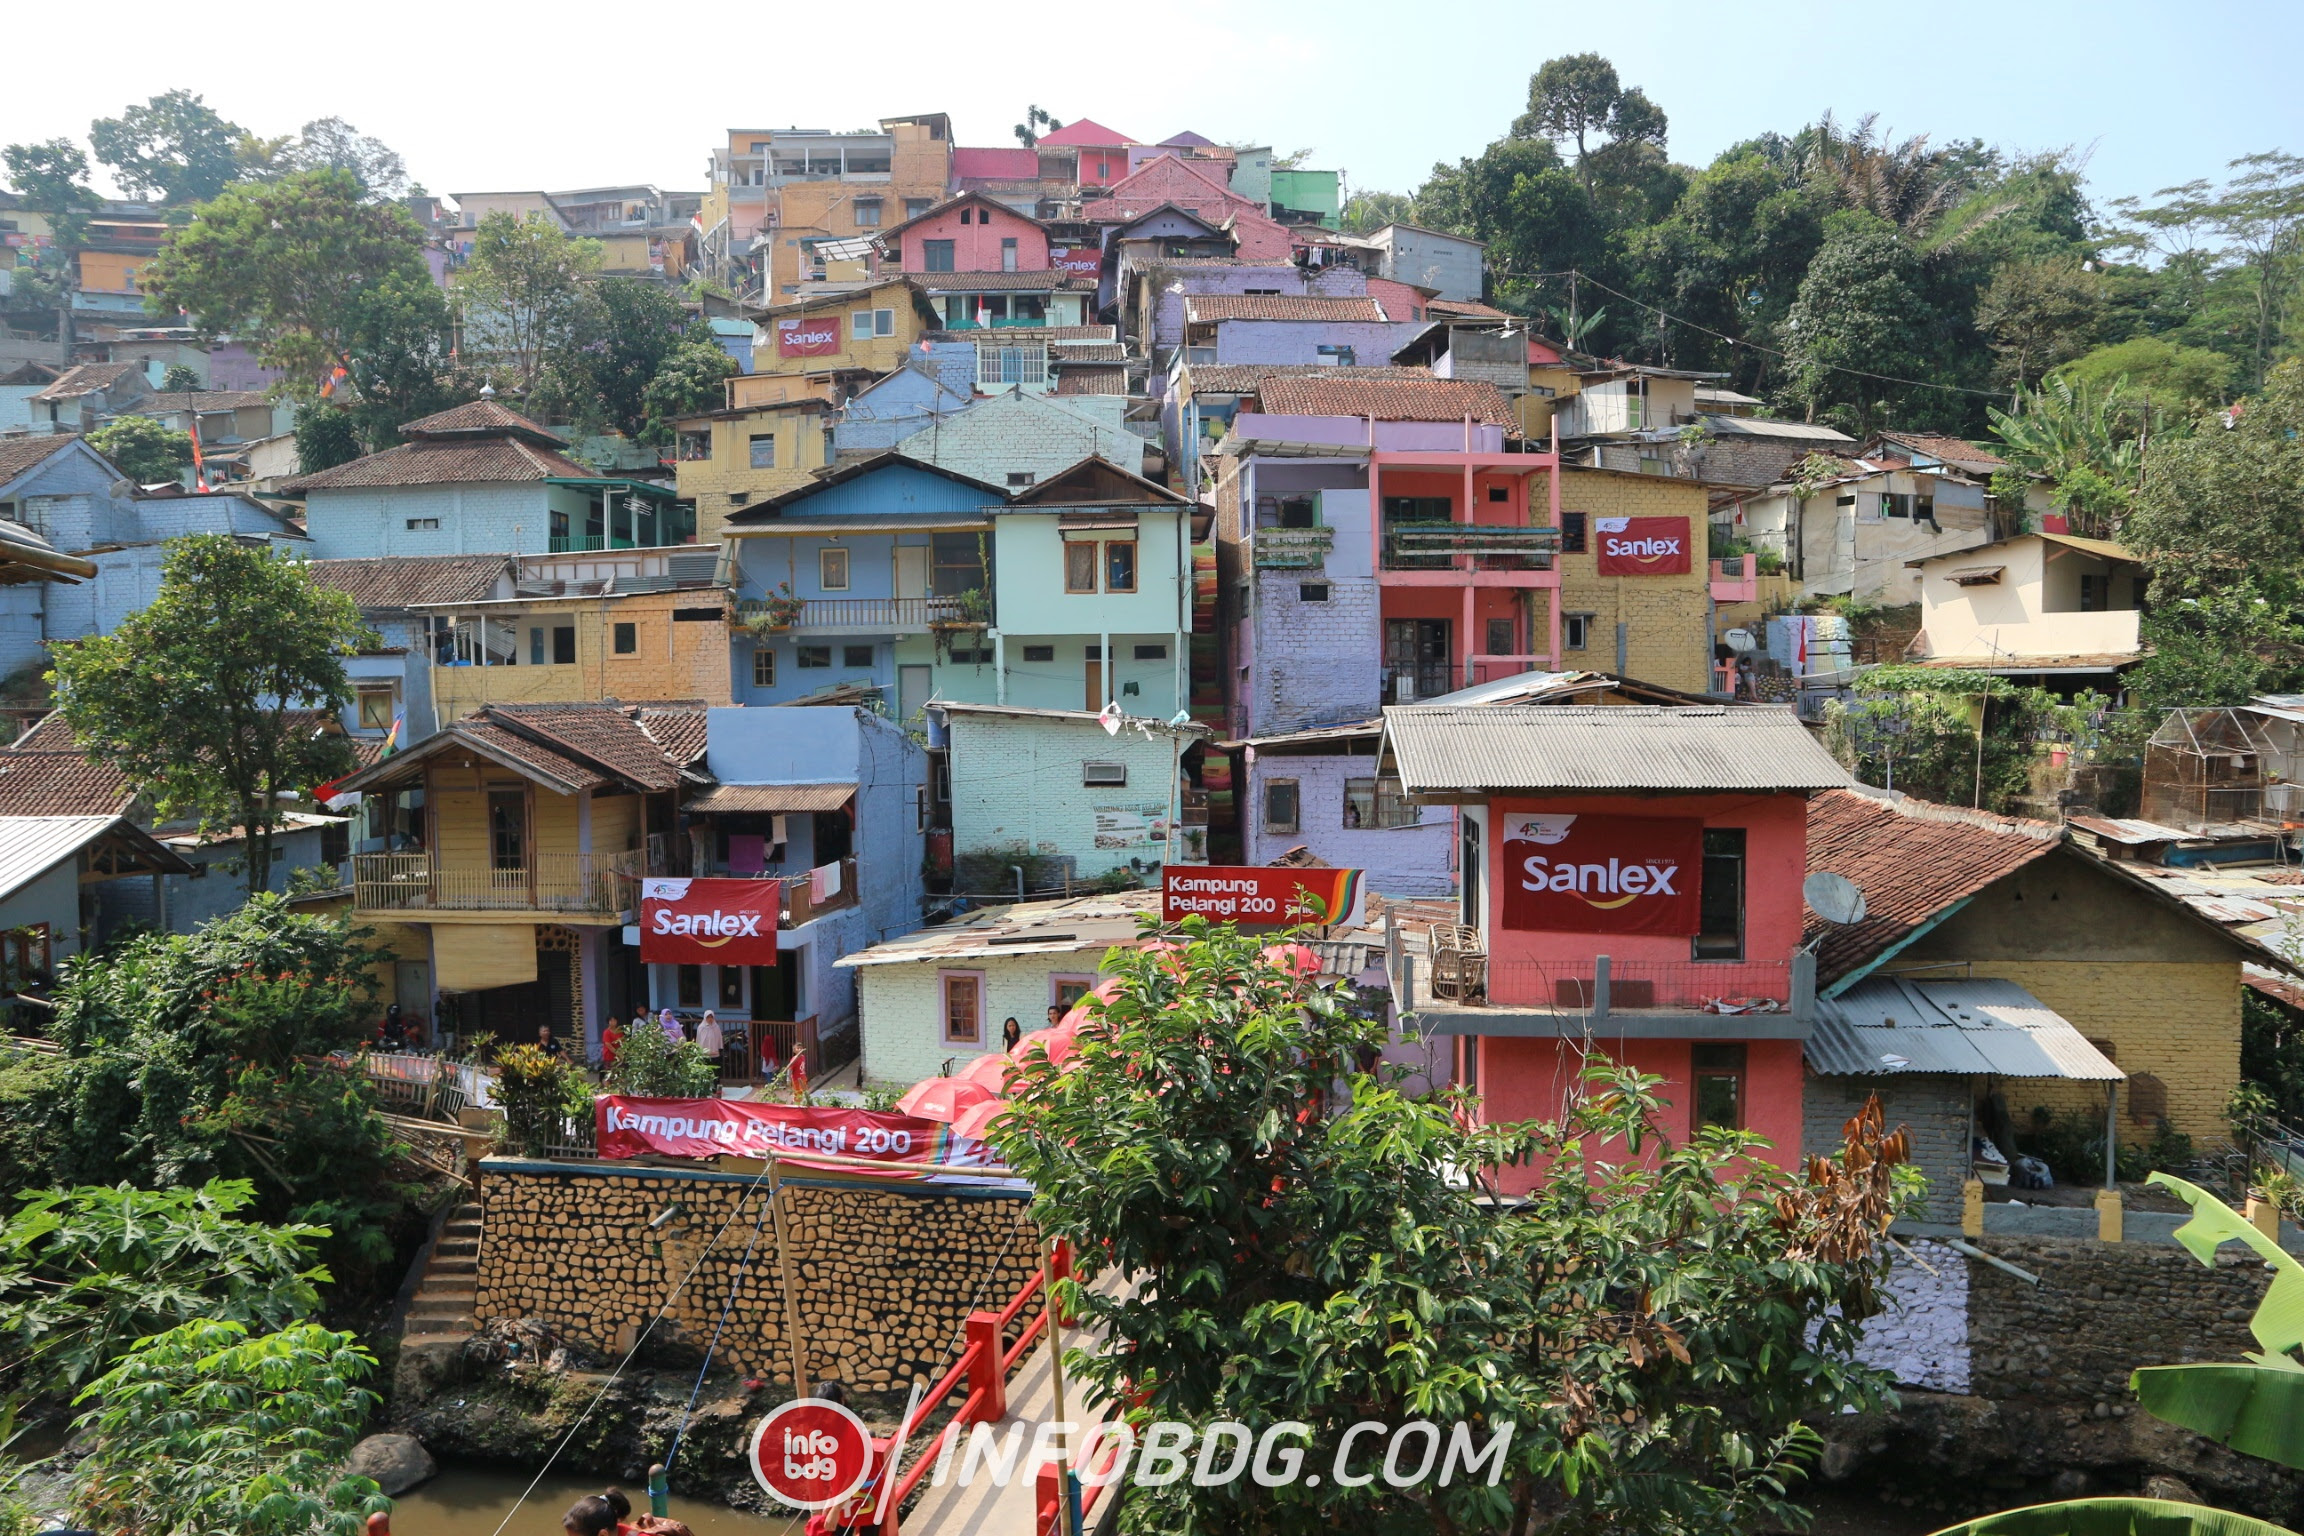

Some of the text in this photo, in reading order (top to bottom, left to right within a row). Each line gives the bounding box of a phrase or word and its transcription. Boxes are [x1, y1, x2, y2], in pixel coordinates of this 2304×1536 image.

[1055, 260, 1097, 271] Sanlex
[784, 331, 833, 345] Sanlex
[1606, 536, 1681, 557] Sanlex
[1519, 822, 1540, 837] 45
[1168, 875, 1258, 896] Kampung
[1522, 855, 1679, 896] Sanlex
[653, 884, 668, 895] 45
[1169, 895, 1277, 915] Pelangi 200
[652, 908, 762, 937] Sanlex
[606, 1106, 911, 1155] Kampung Pelangi 200
